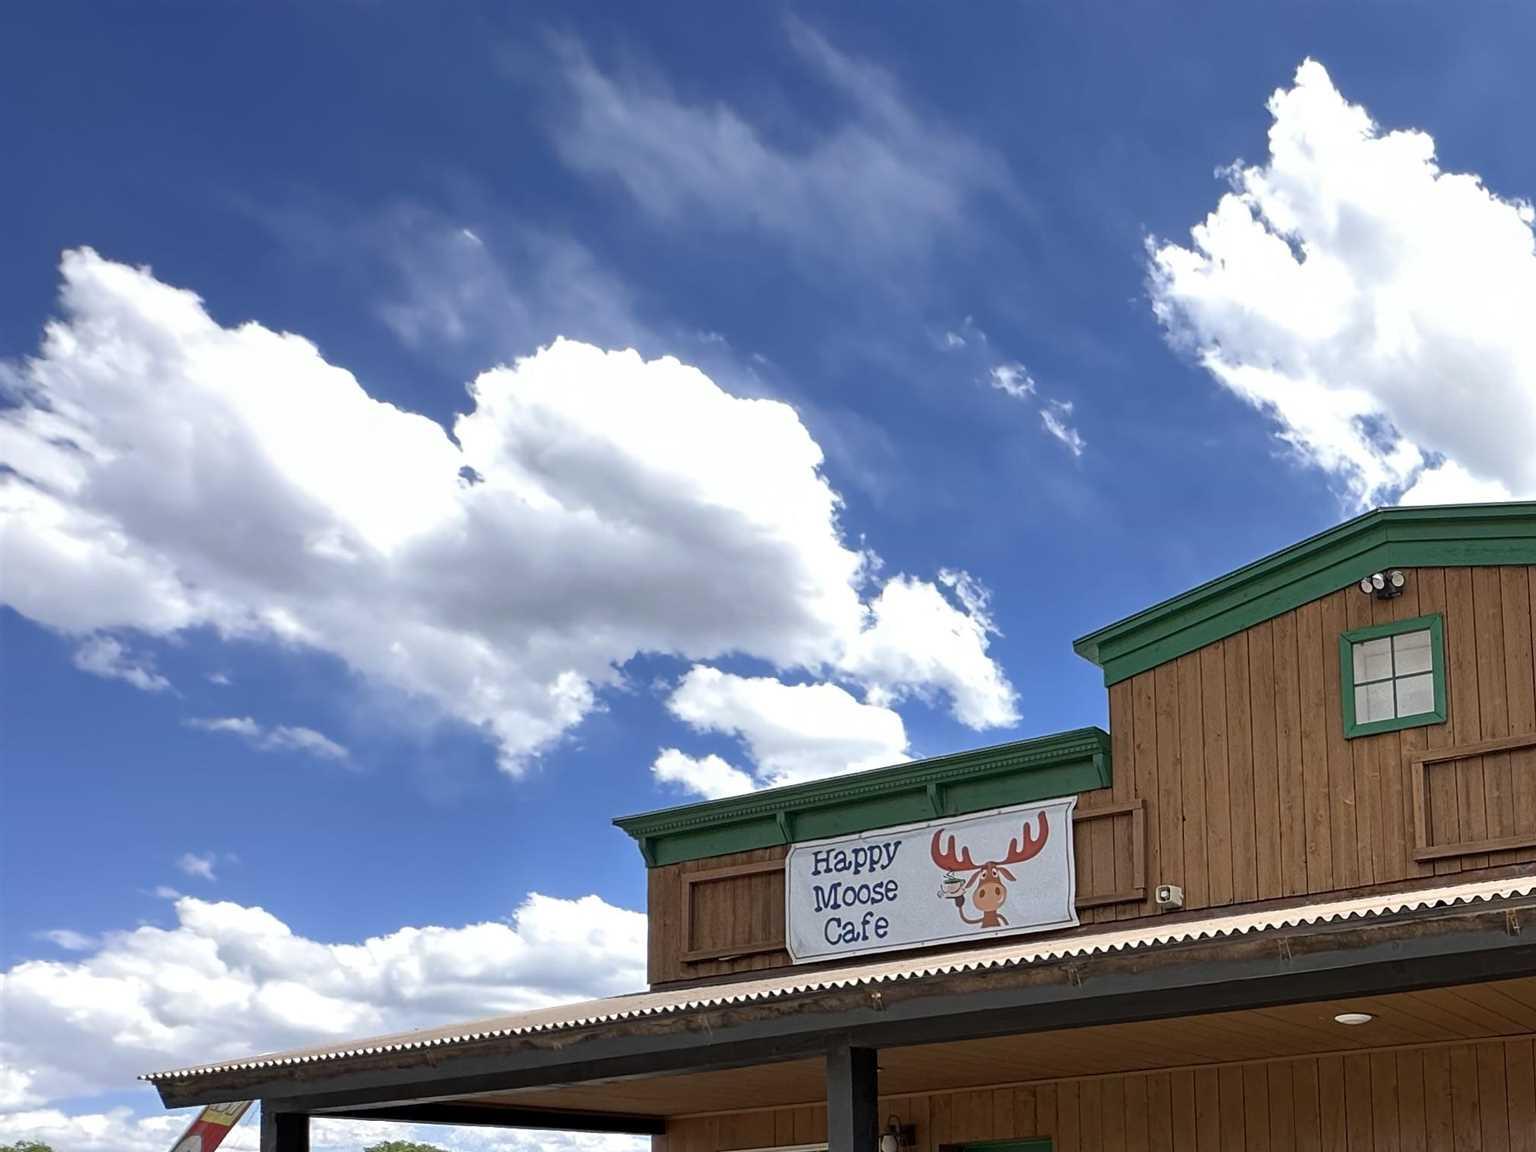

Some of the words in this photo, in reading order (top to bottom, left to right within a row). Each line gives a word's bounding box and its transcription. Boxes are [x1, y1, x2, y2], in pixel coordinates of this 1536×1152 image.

[811, 840, 902, 876] Happy
[813, 878, 899, 913] Moose
[824, 911, 889, 946] Cafe
